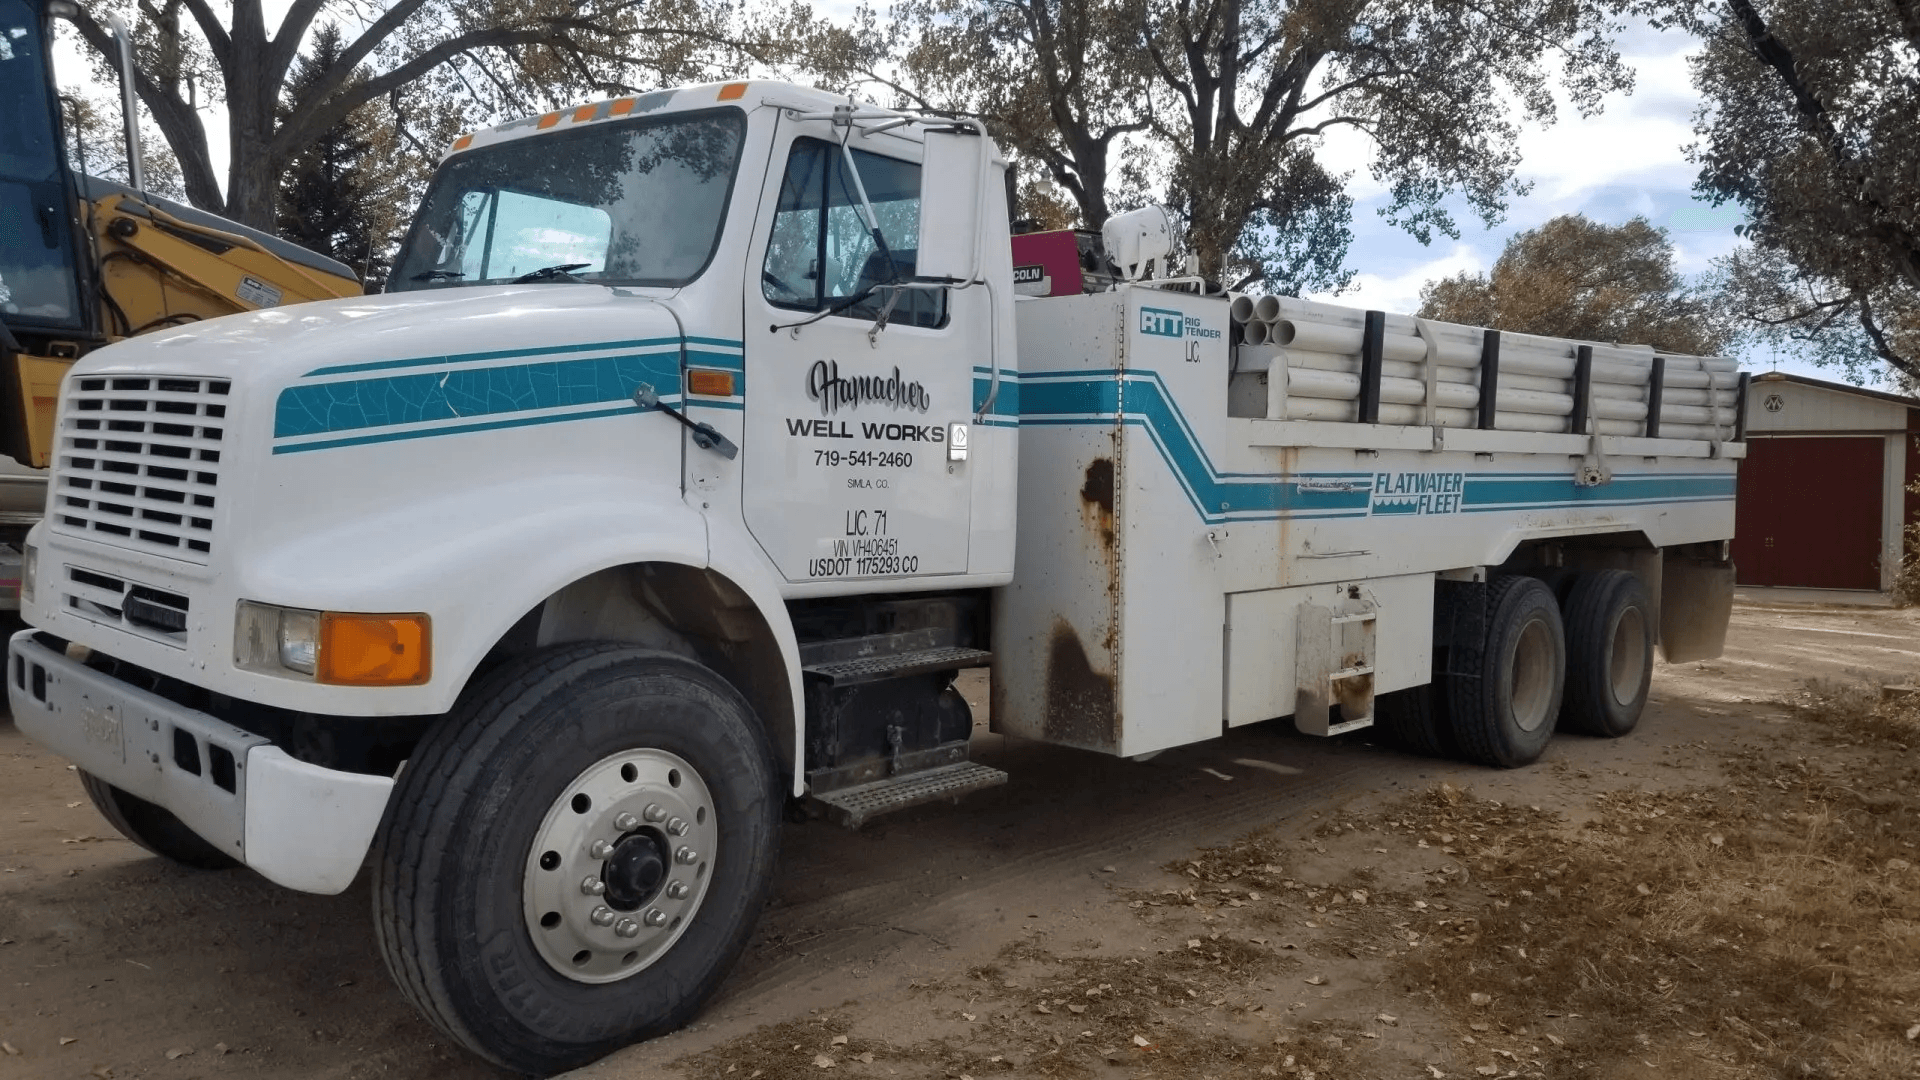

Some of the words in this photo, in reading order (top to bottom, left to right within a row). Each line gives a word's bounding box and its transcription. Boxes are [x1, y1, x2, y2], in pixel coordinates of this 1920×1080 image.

[1141, 310, 1182, 335] RTT
[1185, 316, 1201, 327] RIG
[1186, 327, 1221, 338] TENDER
[806, 359, 930, 416] Hamacher
[786, 418, 854, 439] WELL
[862, 422, 945, 443] WORKS
[814, 450, 913, 468] 719-541-2460
[876, 480, 889, 488] CO.
[1374, 472, 1464, 495] FLATWATER
[1418, 494, 1461, 515] FLEET
[846, 509, 869, 536] LIC.
[874, 509, 887, 536] 71
[833, 539, 849, 557] VIN
[853, 538, 898, 557] VH406451
[809, 557, 852, 577] USDOT
[856, 556, 900, 575] 1175293
[902, 555, 919, 573] CO
